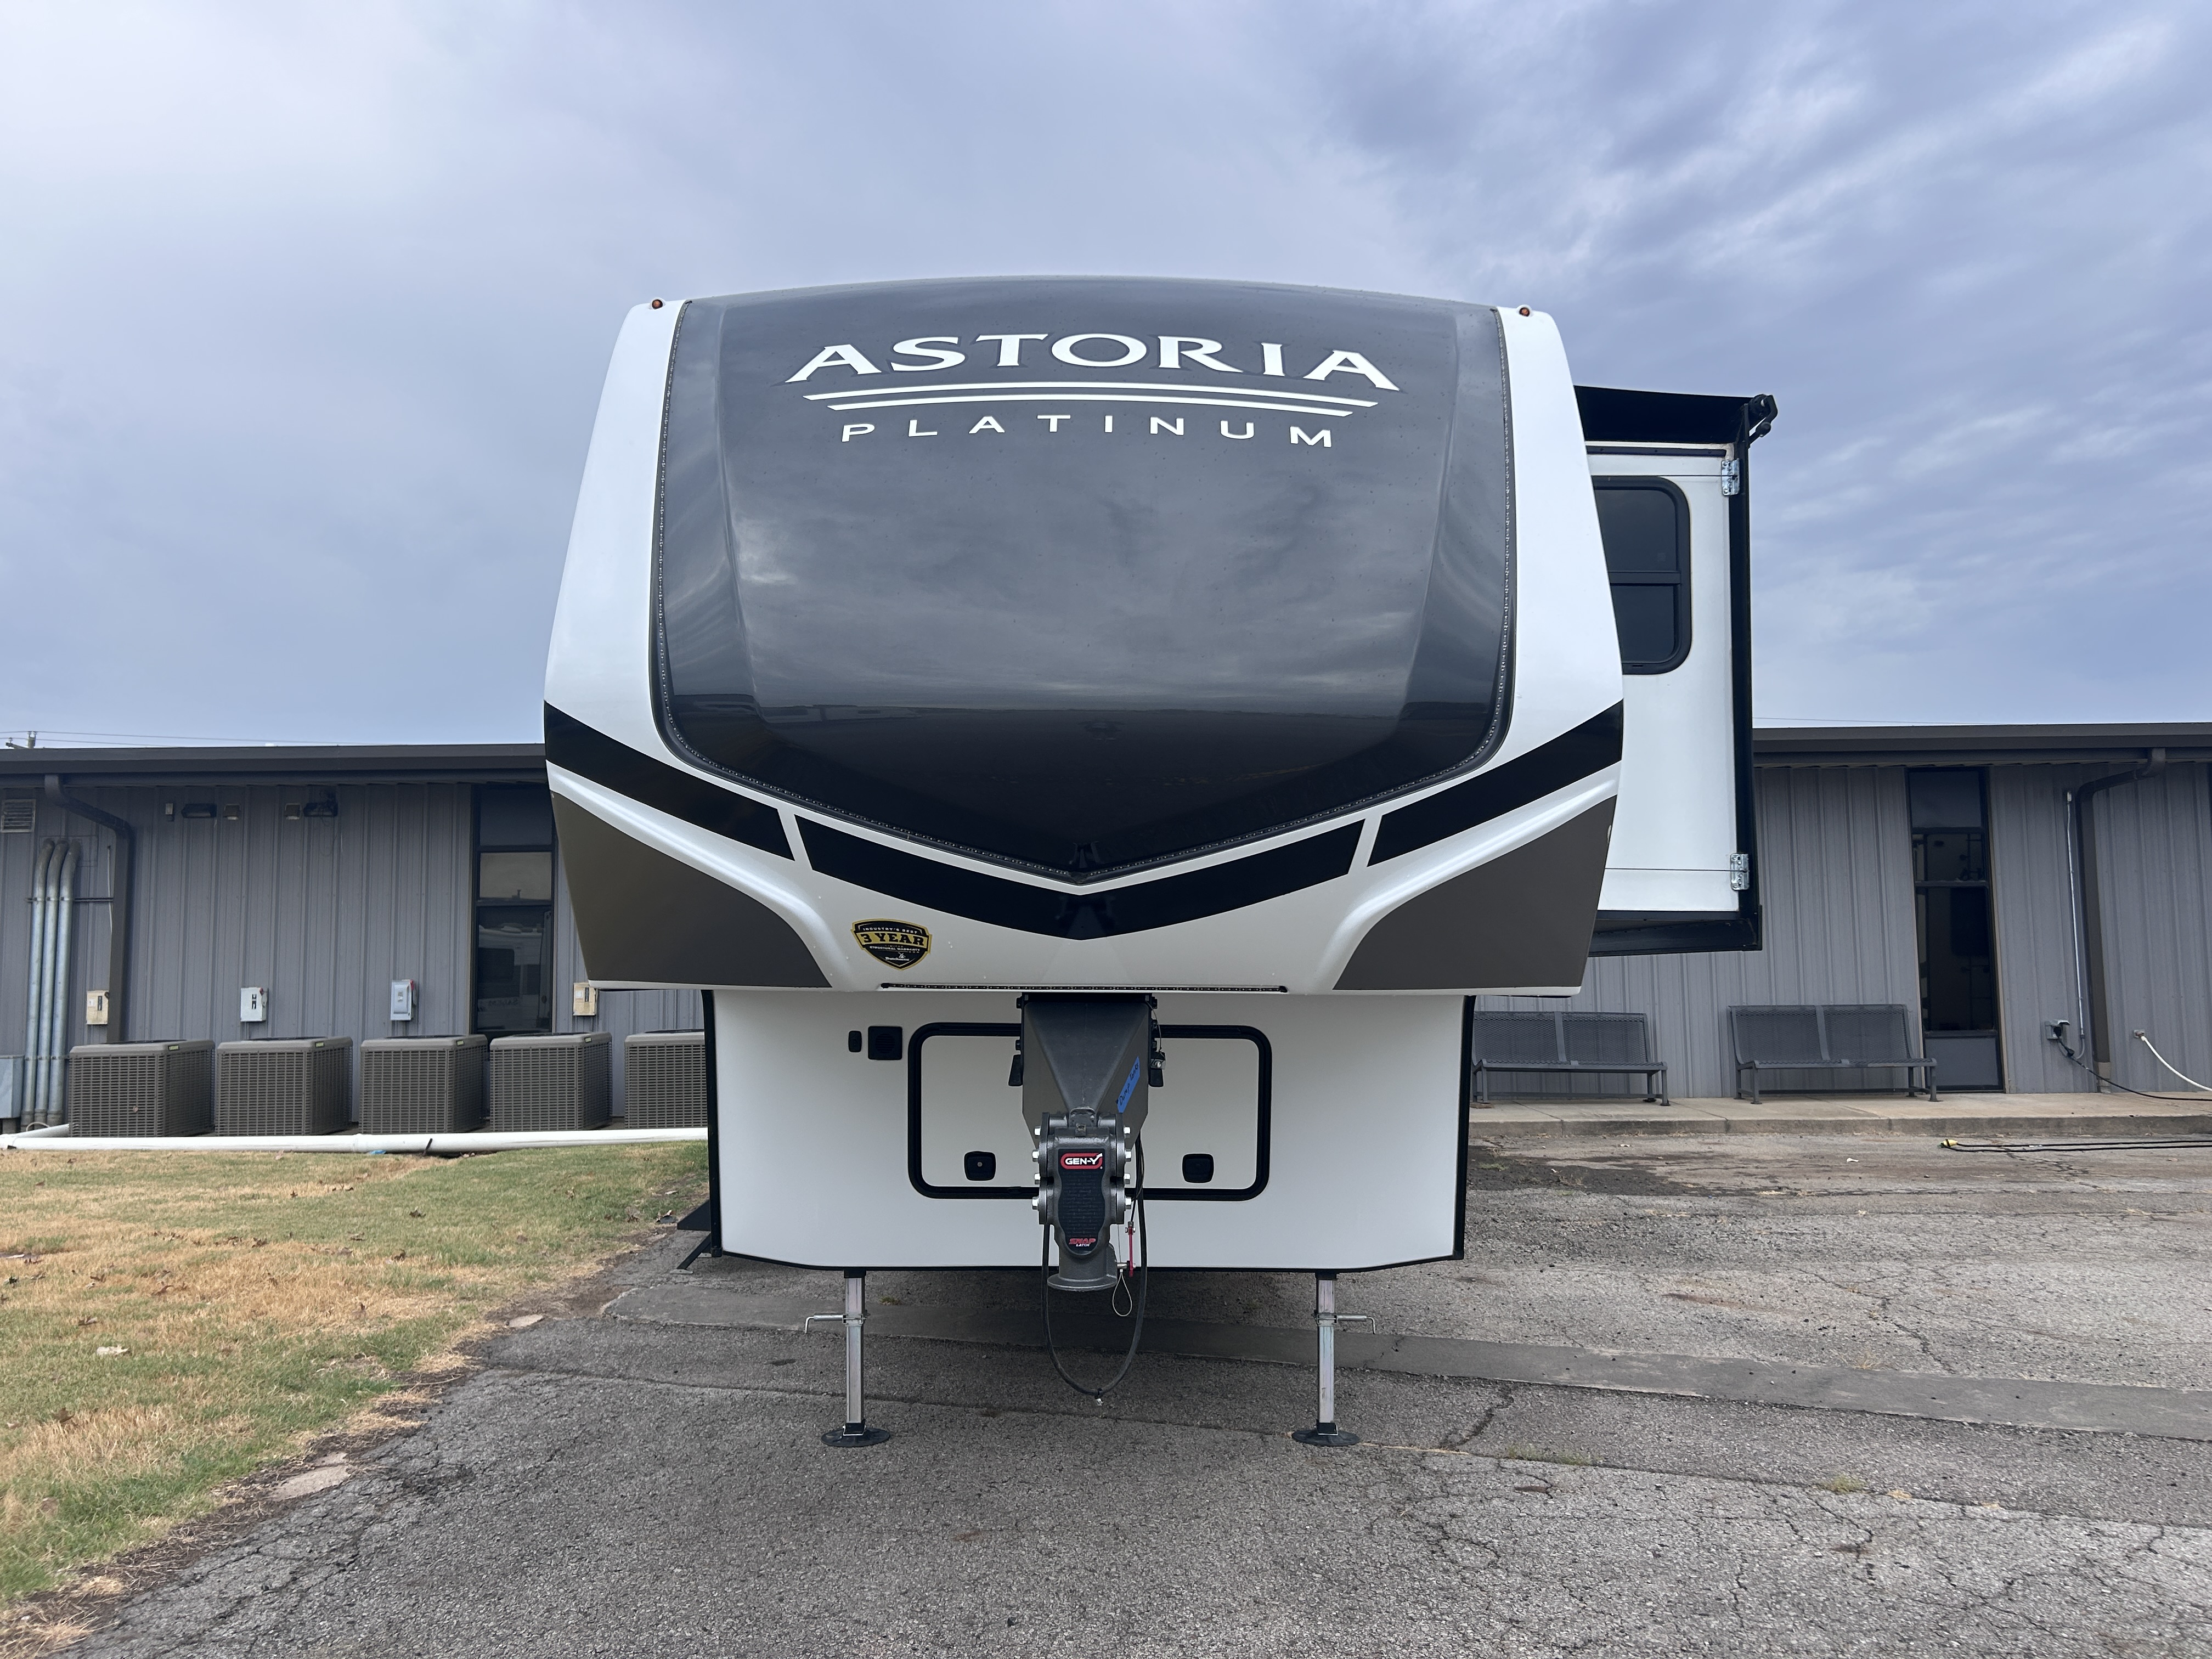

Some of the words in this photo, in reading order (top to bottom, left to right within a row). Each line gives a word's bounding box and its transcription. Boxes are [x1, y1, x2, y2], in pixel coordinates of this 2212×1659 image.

[785, 333, 1400, 392] ASTORIA
[841, 414, 1333, 448] PLATINUM
[860, 934, 872, 943] 3
[874, 933, 924, 946] YEAR
[1065, 1153, 1103, 1165] GEN-Y
